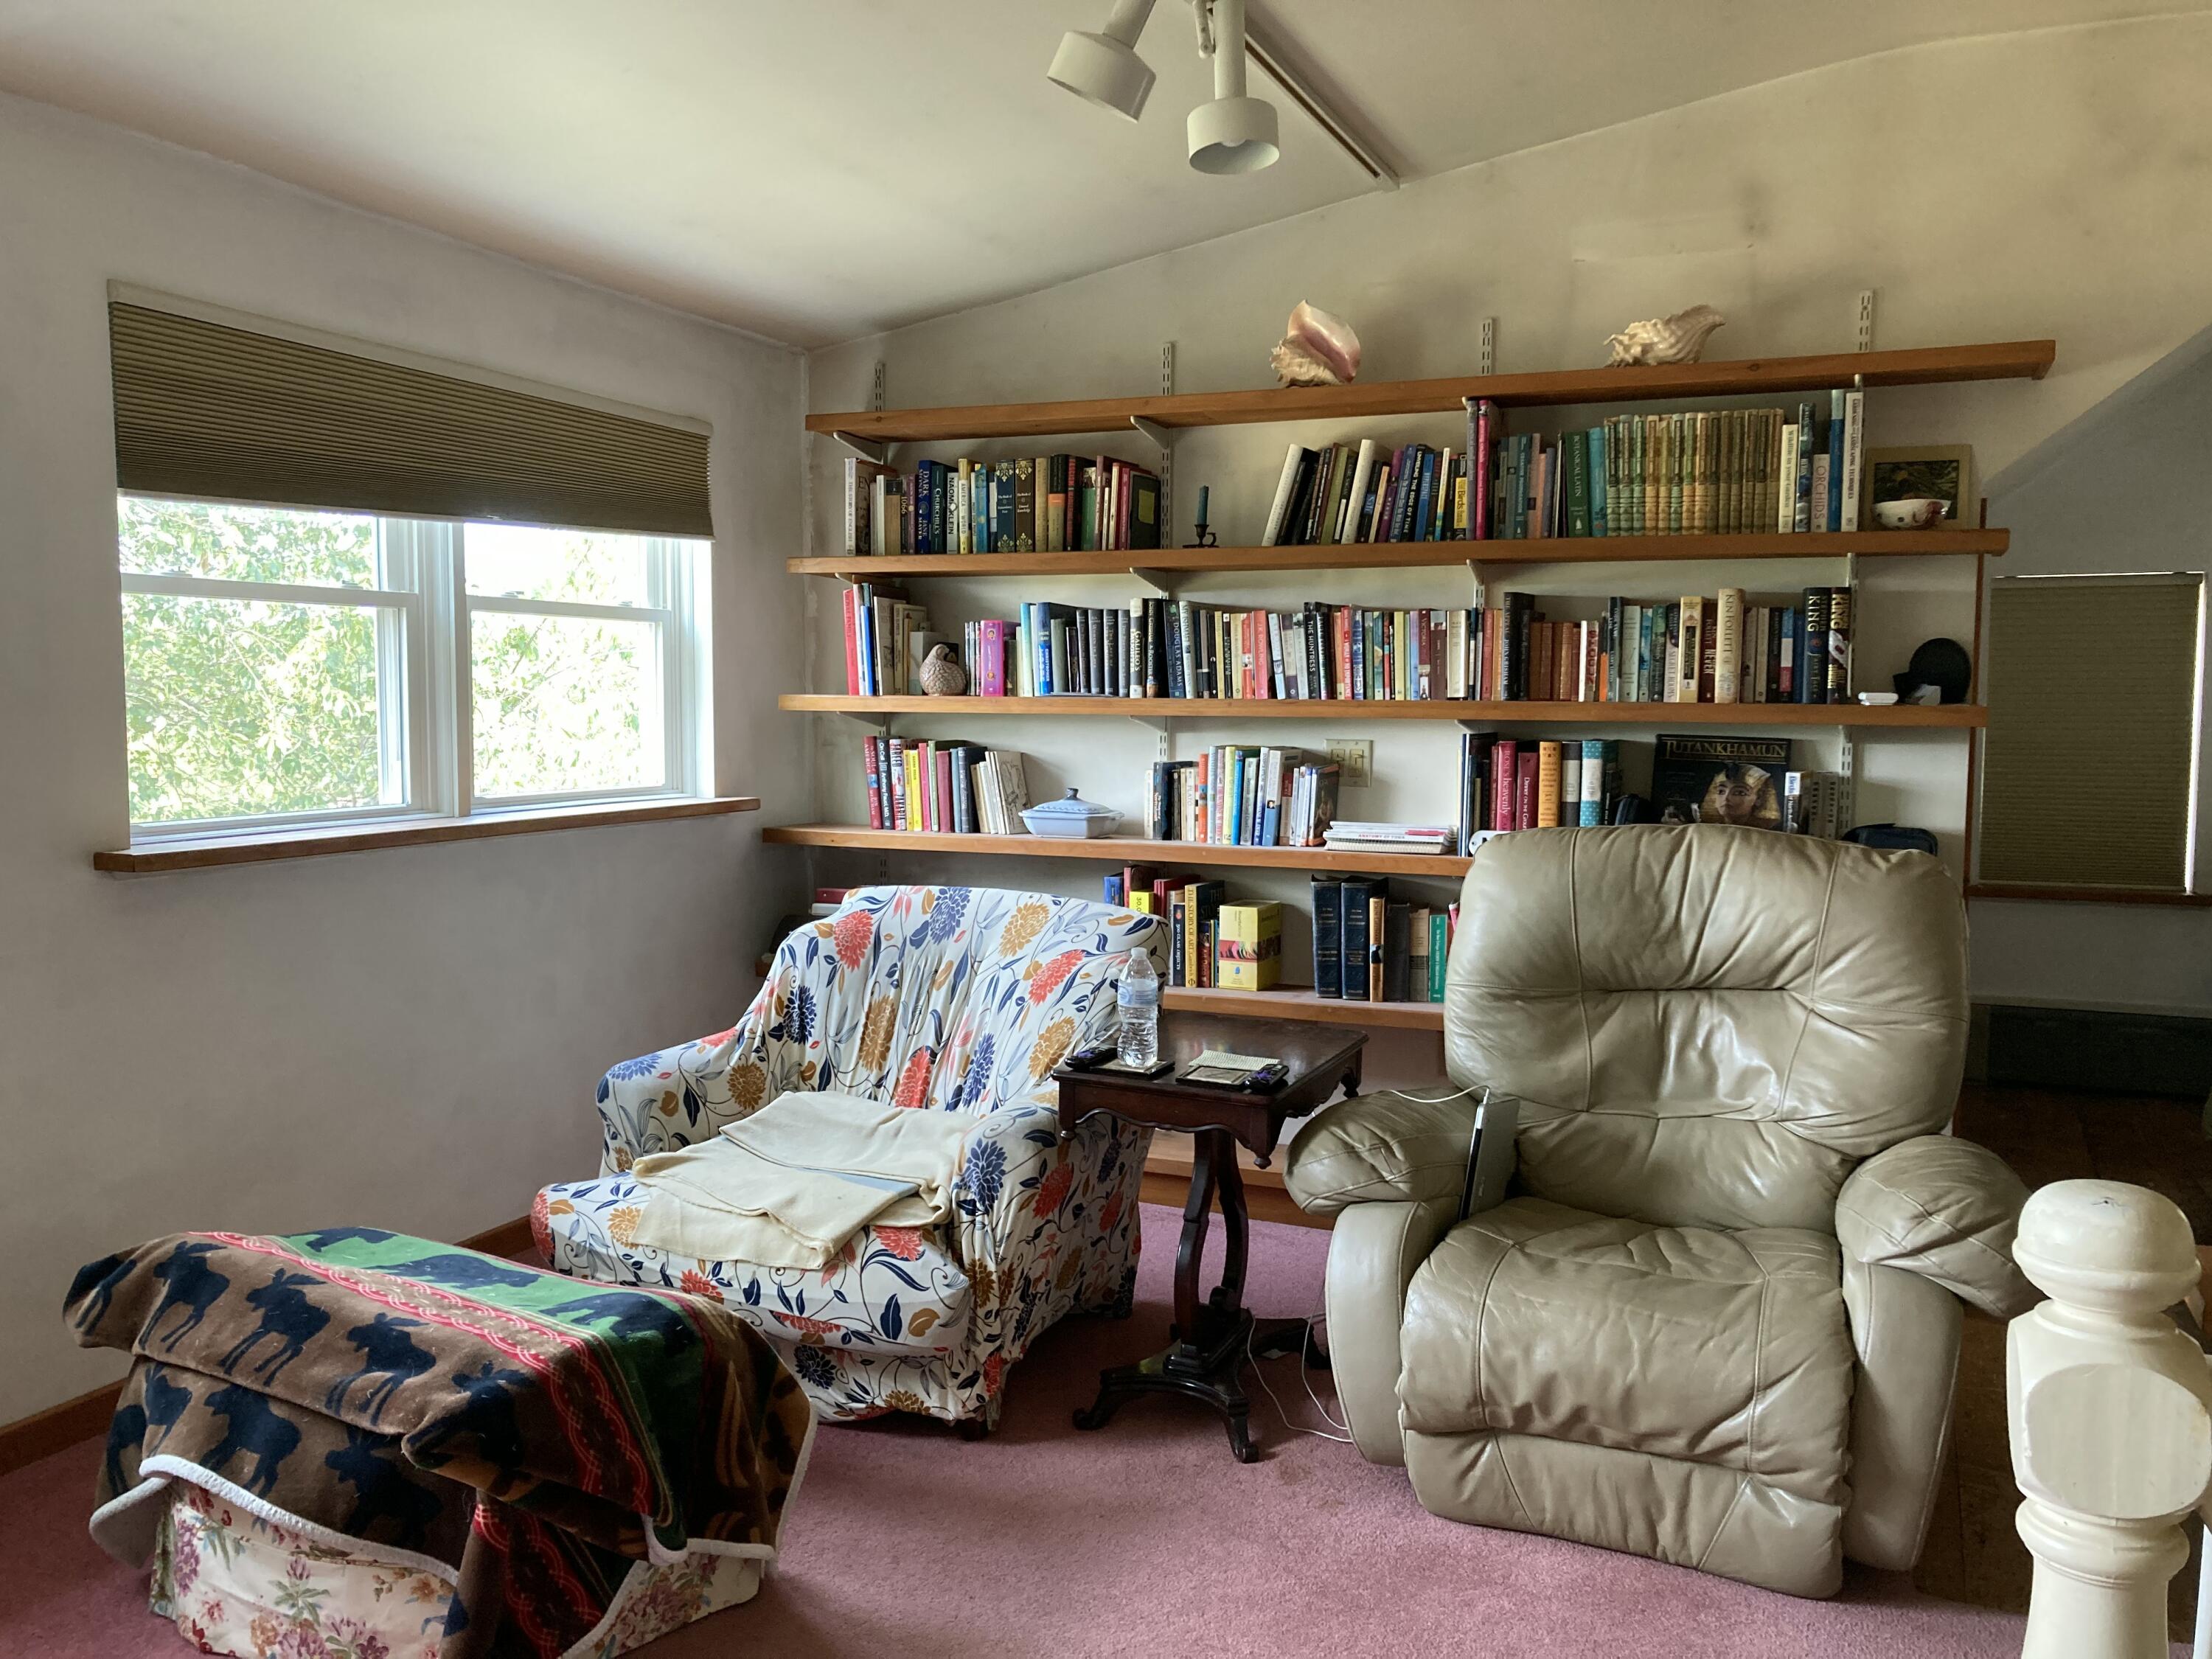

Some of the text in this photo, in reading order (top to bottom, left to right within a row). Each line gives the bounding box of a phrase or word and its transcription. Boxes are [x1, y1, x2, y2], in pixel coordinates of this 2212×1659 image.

[1786, 429, 1795, 456] Wildlife
[1413, 451, 1422, 478] UNVEILING
[1420, 472, 1430, 500] HYPERSPACE
[1573, 476, 1582, 497] LATIN
[1814, 466, 1827, 519] ORCHIDS
[933, 488, 942, 535] CHURCHILL'S
[1405, 507, 1413, 516] OF
[1457, 490, 1466, 509] Birds
[1402, 518, 1411, 534] TIME
[1181, 605, 1189, 615] MY
[1806, 596, 1821, 631] KING
[1830, 593, 1845, 630] KING
[1703, 619, 1712, 644] FOLLETT
[1722, 594, 1736, 652] KEN FOLLETT
[1172, 622, 1181, 658] DOUGLAS
[1703, 649, 1717, 674] NEVER
[1666, 677, 1675, 699] ROOMS
[879, 742, 885, 751] On
[1663, 740, 1787, 759] TUTANKHAMUN
[891, 743, 905, 821] FAREED ZAKARIA
[1789, 776, 1798, 795] Birds
[1498, 777, 1512, 815] heavenly
[1187, 926, 1194, 938] OF
